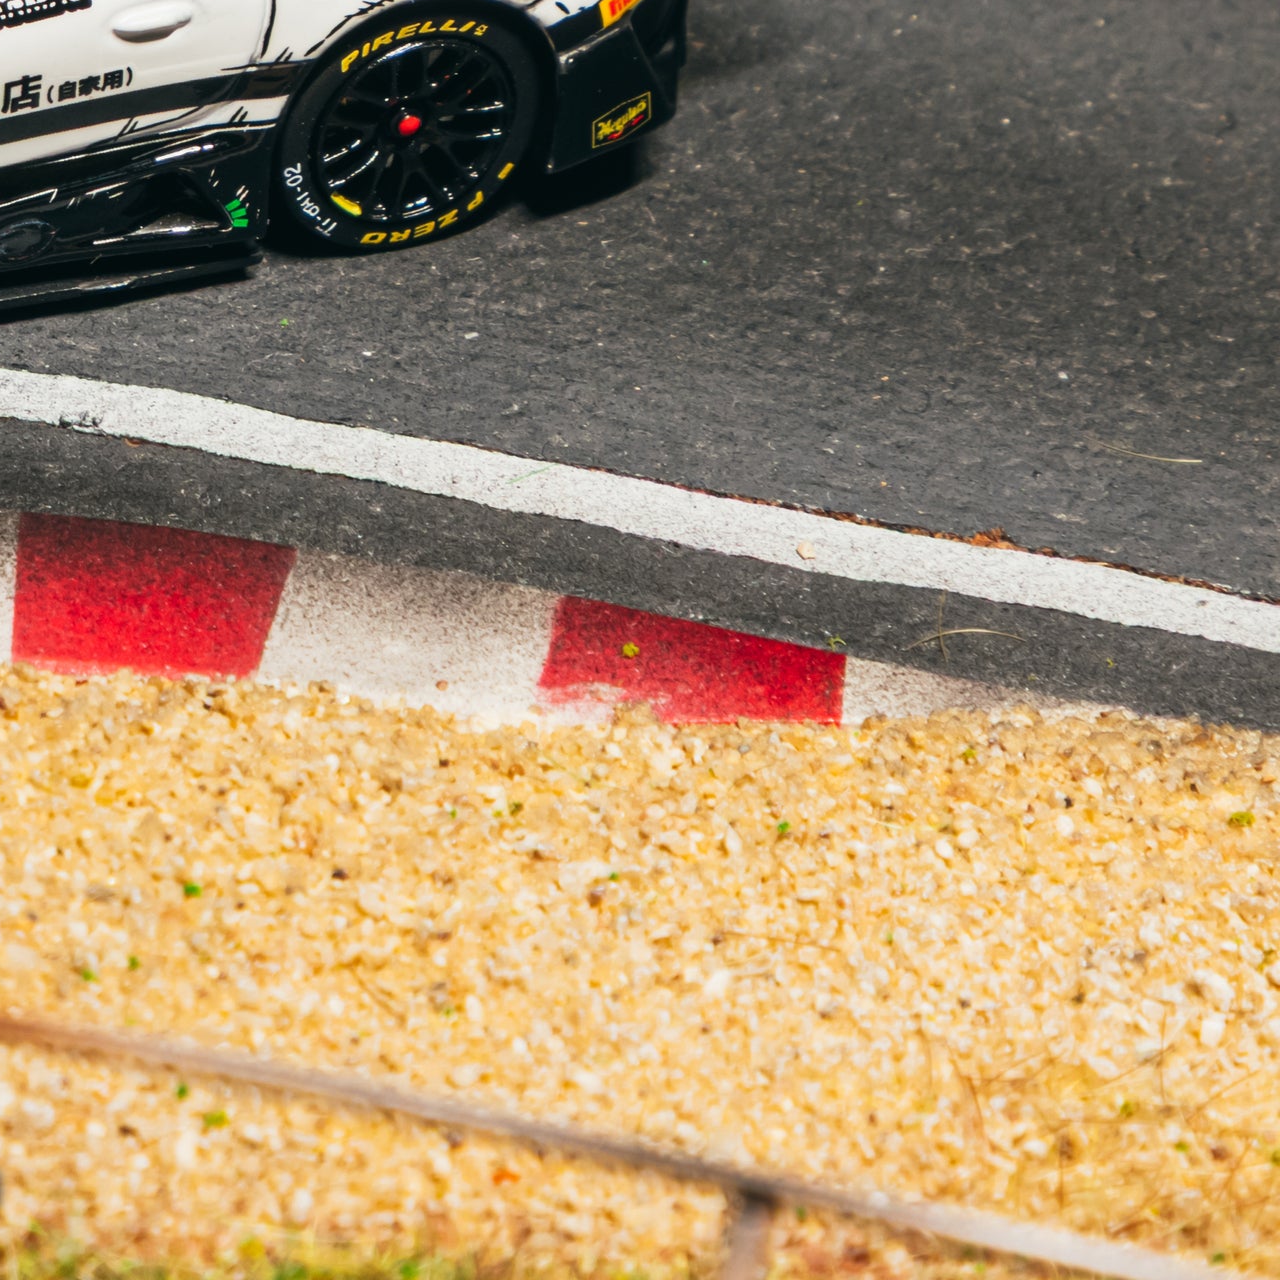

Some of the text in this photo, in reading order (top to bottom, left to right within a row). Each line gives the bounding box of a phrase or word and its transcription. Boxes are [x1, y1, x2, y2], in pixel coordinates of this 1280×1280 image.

[341, 19, 477, 73] PIRELLI
[360, 190, 484, 244] P ZERO
